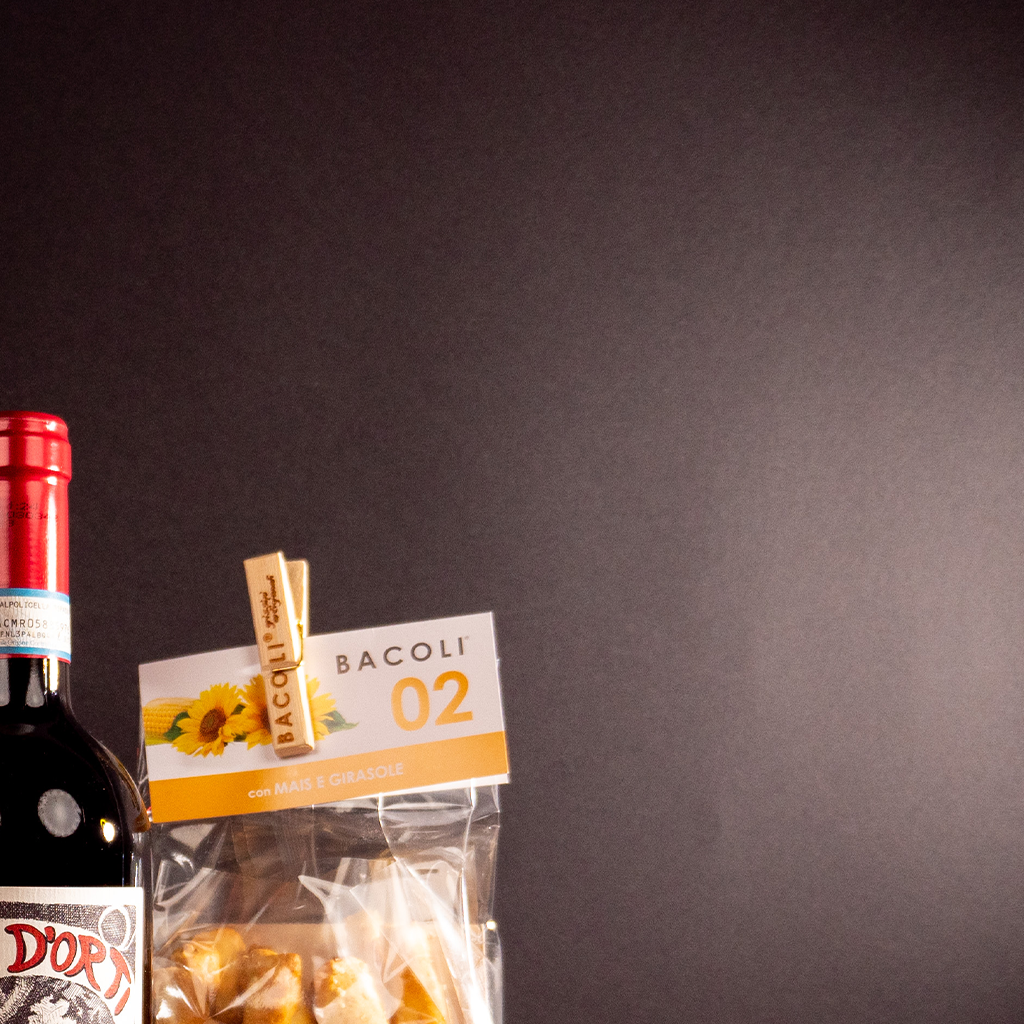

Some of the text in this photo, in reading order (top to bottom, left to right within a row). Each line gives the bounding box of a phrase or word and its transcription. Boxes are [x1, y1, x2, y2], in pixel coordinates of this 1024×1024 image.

[336, 637, 464, 674] BACOLI
[390, 670, 474, 732] 02
[248, 762, 404, 799] con MAIS E GIRASOLE
[4, 923, 132, 1016] D'ORTI
